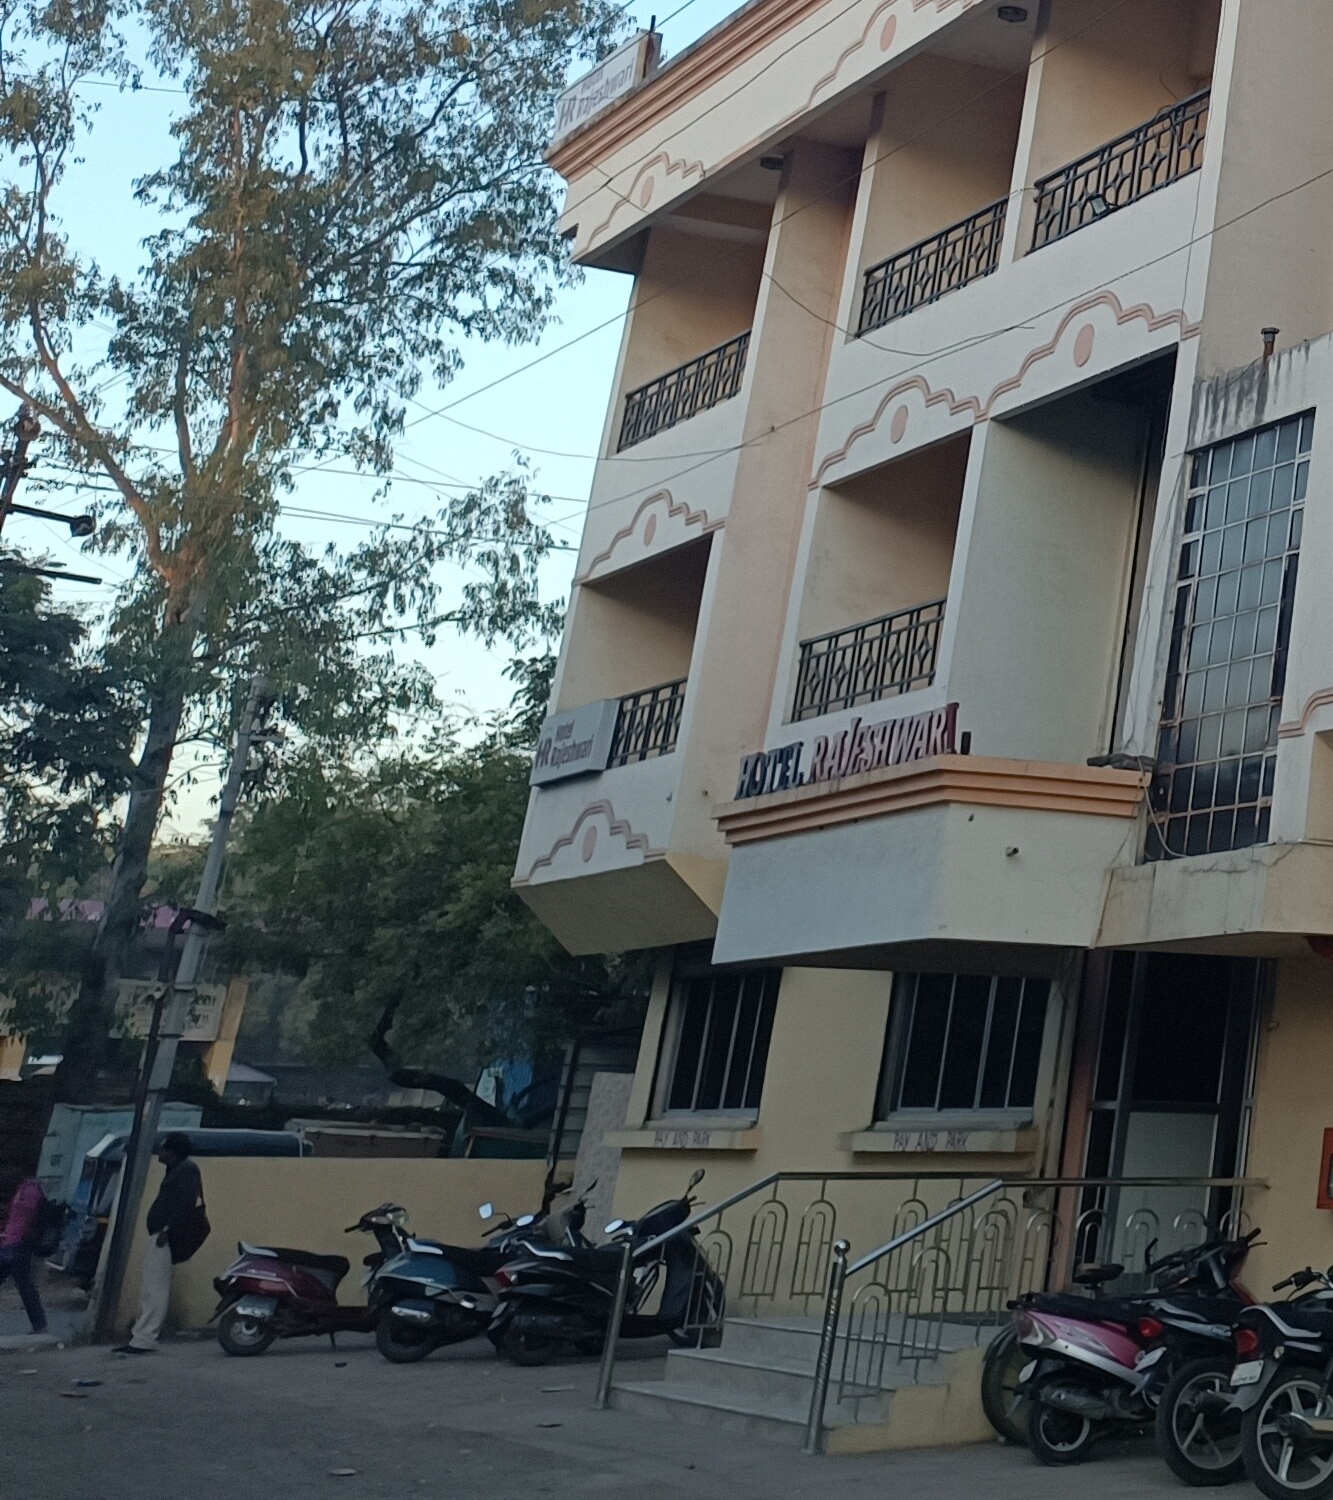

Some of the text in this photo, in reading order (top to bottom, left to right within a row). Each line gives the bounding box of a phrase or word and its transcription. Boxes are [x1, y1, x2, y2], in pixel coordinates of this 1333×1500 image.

[535, 734, 595, 769] HR Rajeshwari
[735, 702, 960, 800] HOTEL RAJESHWARI
